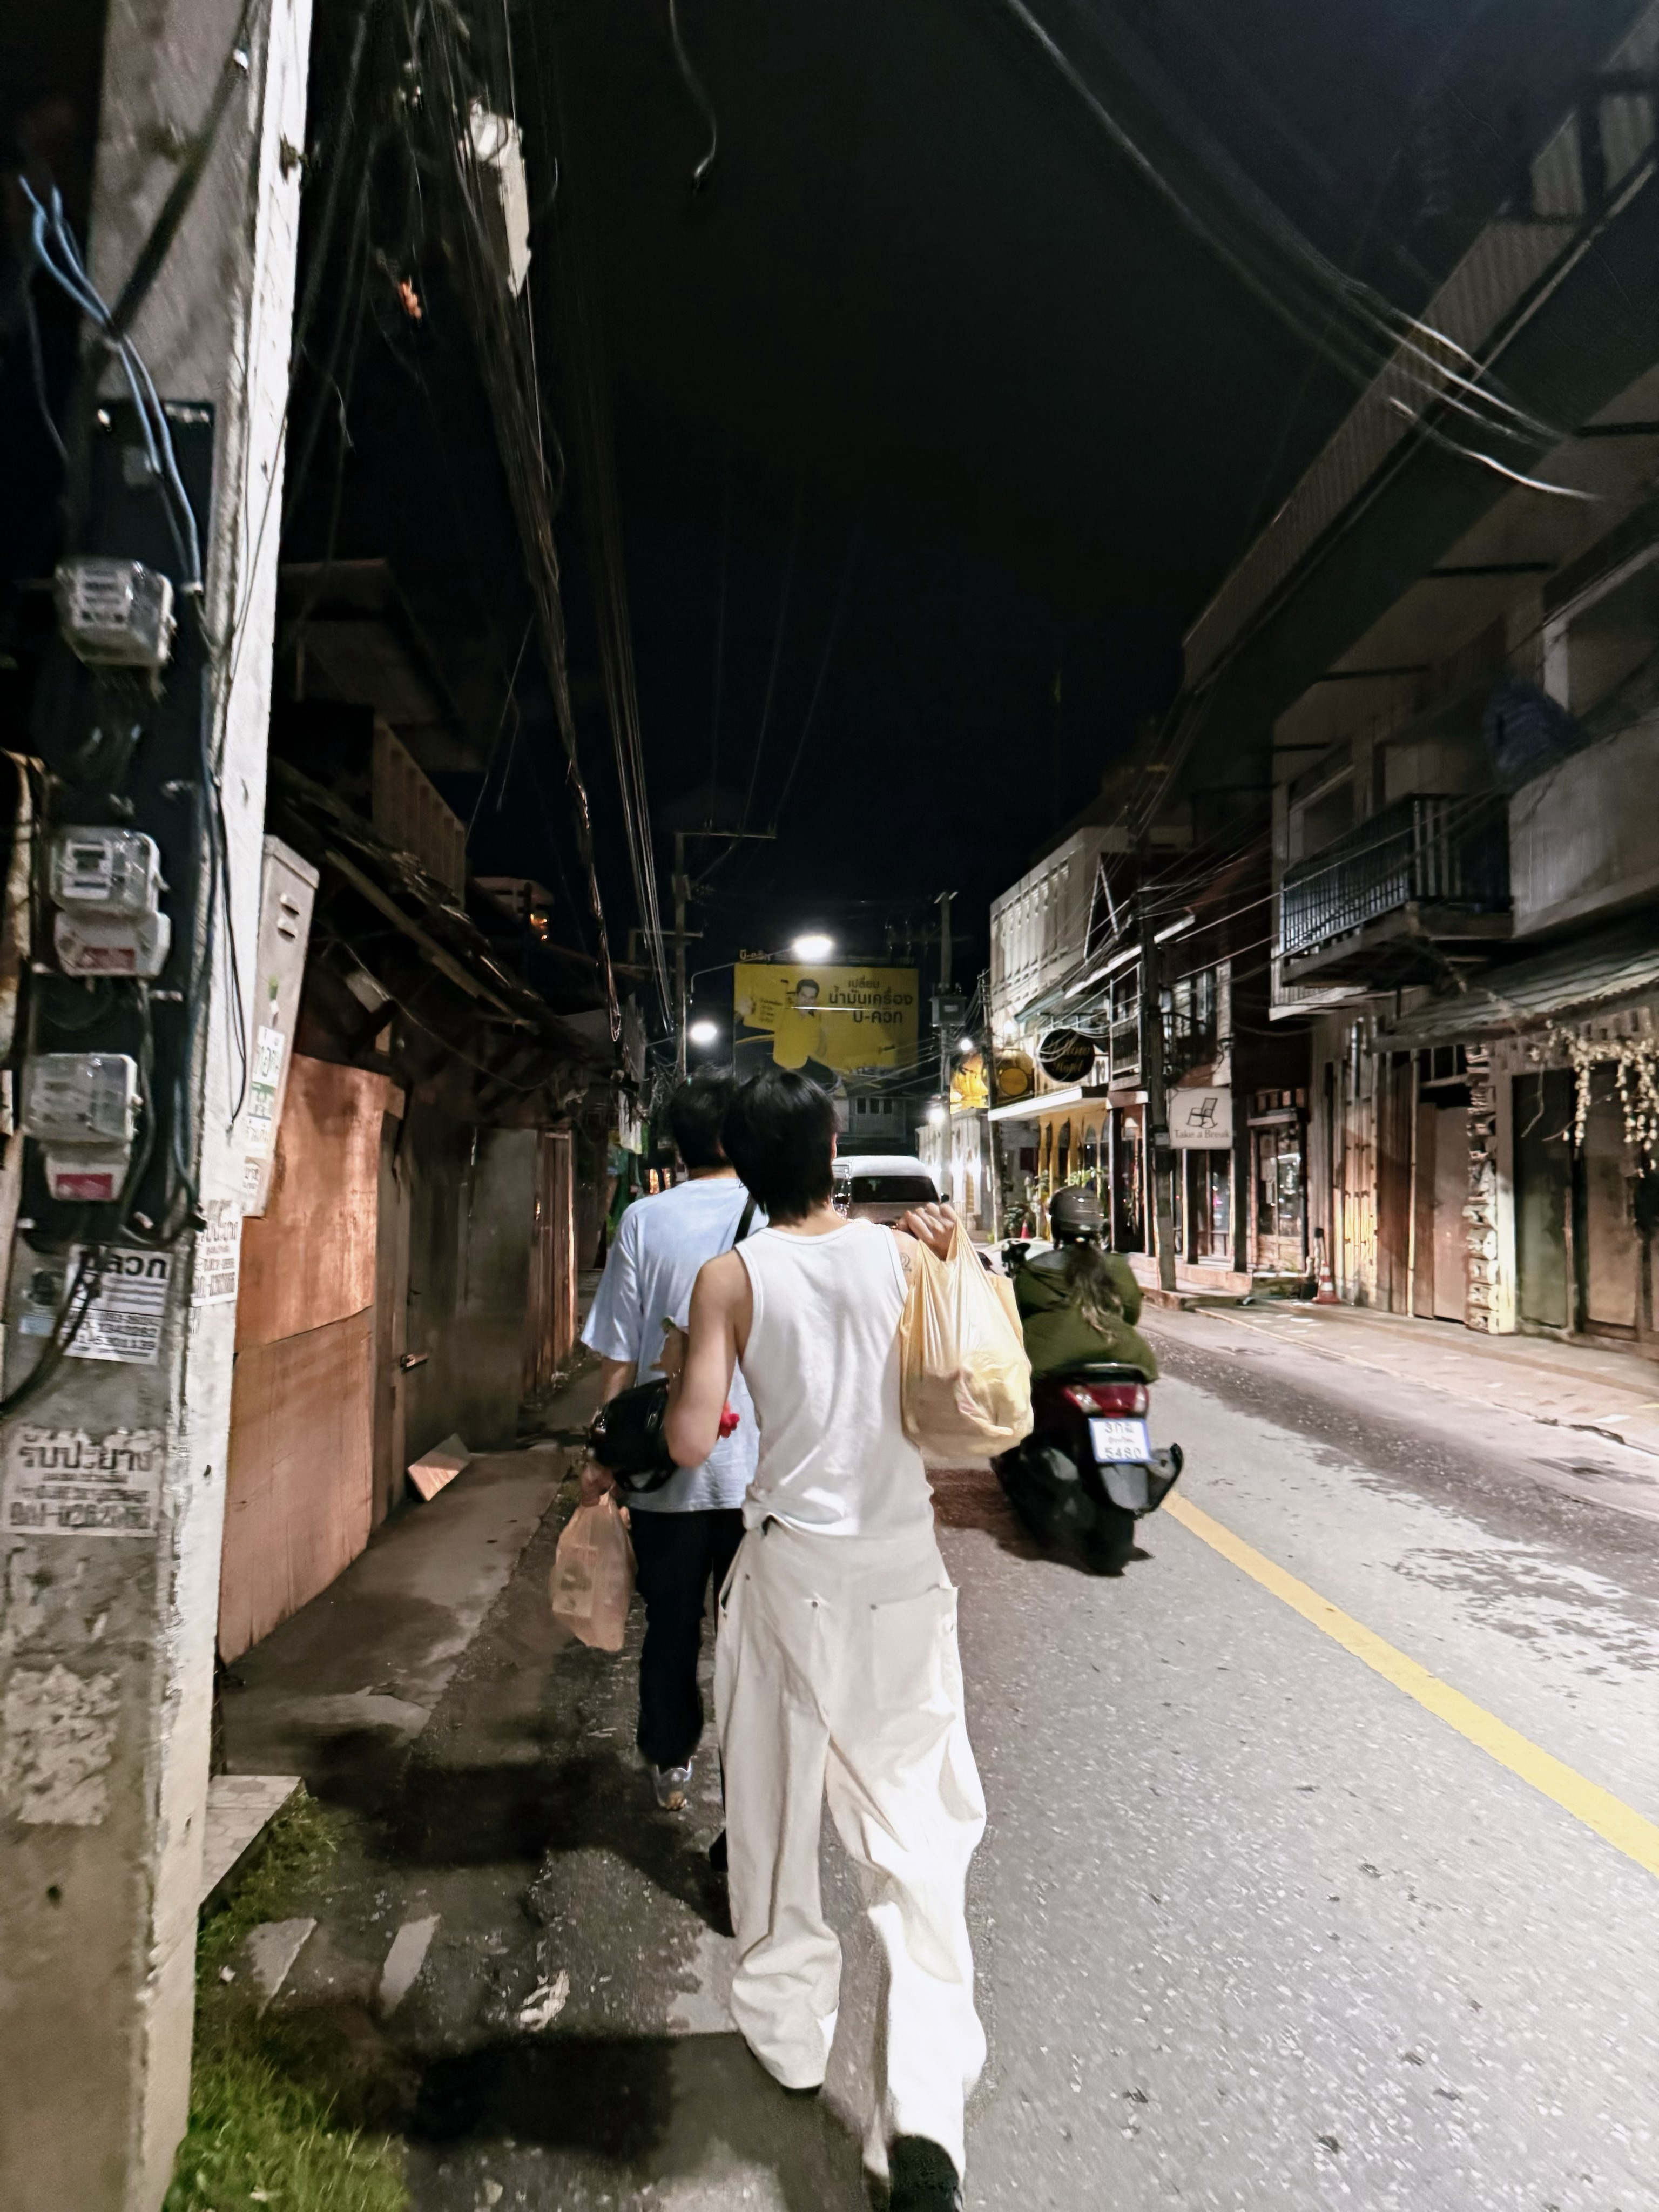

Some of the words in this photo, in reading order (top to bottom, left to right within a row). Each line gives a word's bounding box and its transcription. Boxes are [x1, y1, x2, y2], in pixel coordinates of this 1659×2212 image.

[829, 986, 913, 1005] น้ำมันเครื่อง
[1175, 1130, 1195, 1138] Take
[1205, 1129, 1229, 1138] Break
